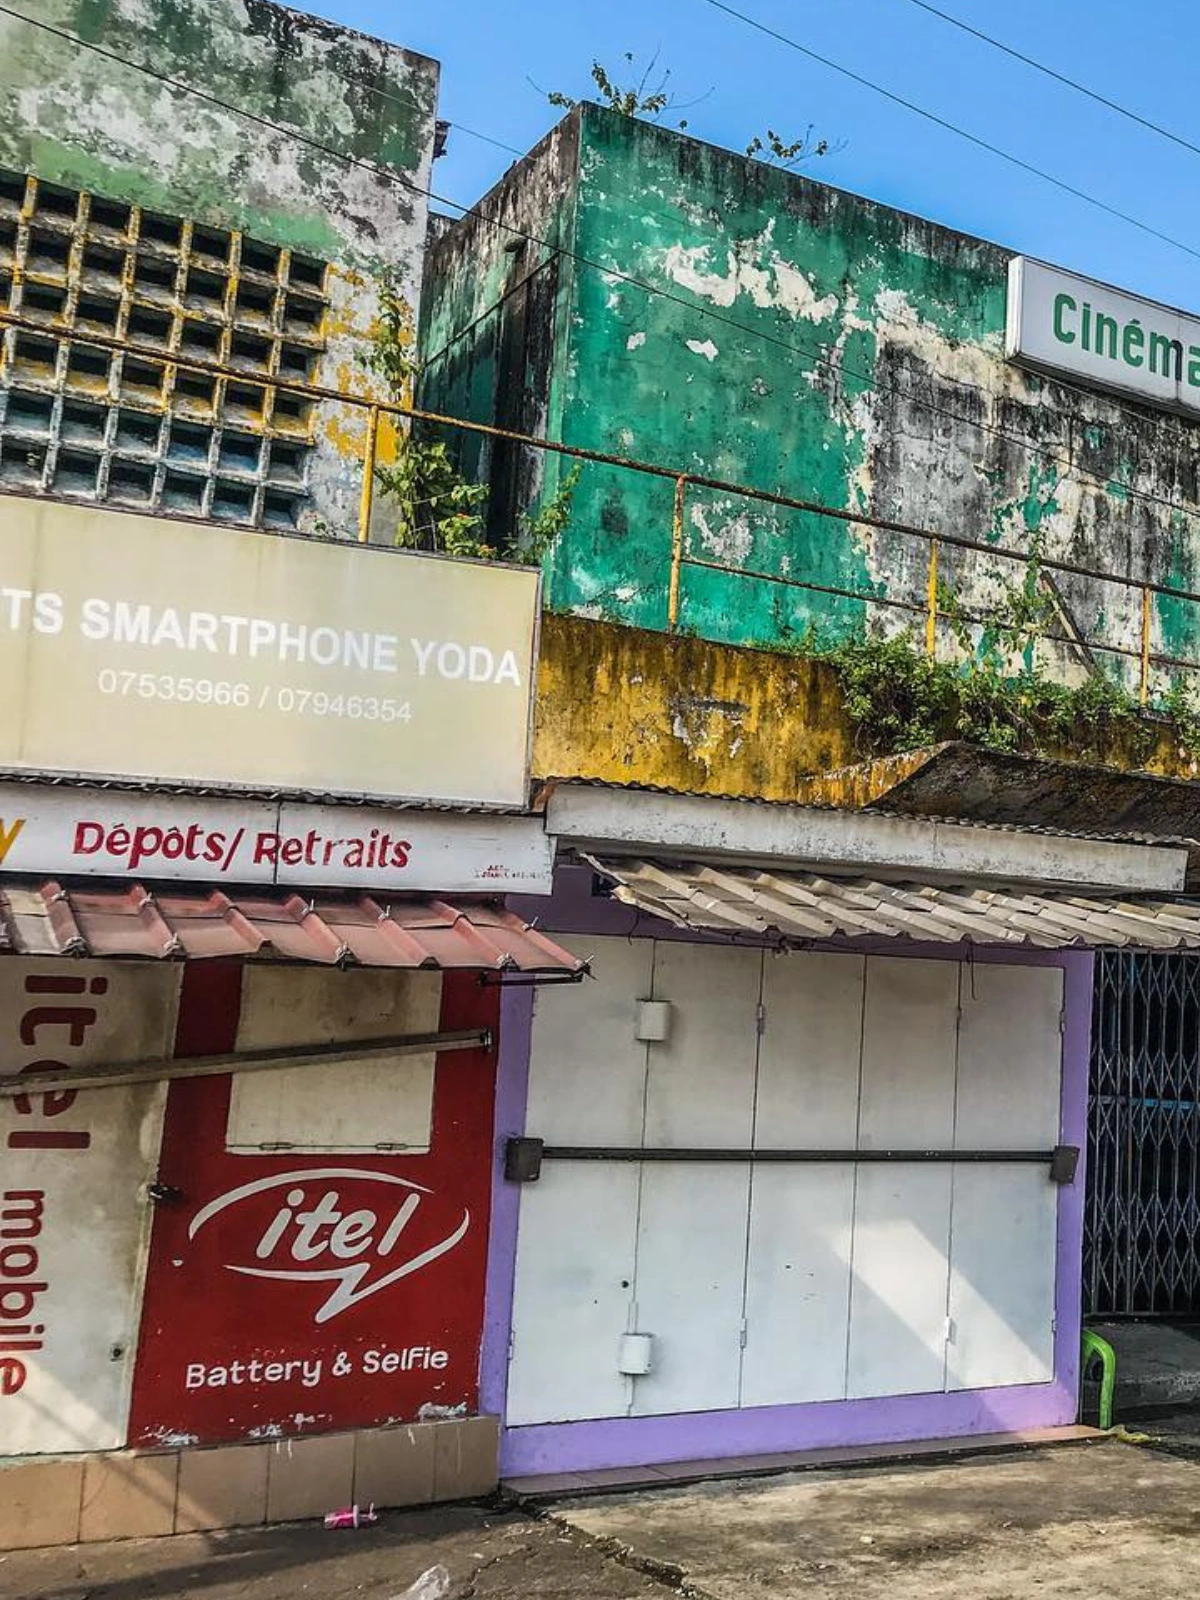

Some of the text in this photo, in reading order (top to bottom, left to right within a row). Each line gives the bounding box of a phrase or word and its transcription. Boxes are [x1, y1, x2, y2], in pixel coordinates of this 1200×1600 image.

[0, 588, 521, 686] TS SMARTPHONE YODA
[98, 669, 250, 706] 07535966
[277, 688, 412, 723] 07946354
[253, 829, 413, 869] Retraits
[256, 1189, 420, 1261] itel
[0, 1190, 49, 1395] mobile
[186, 1360, 322, 1388] Battery
[332, 1351, 353, 1377] &
